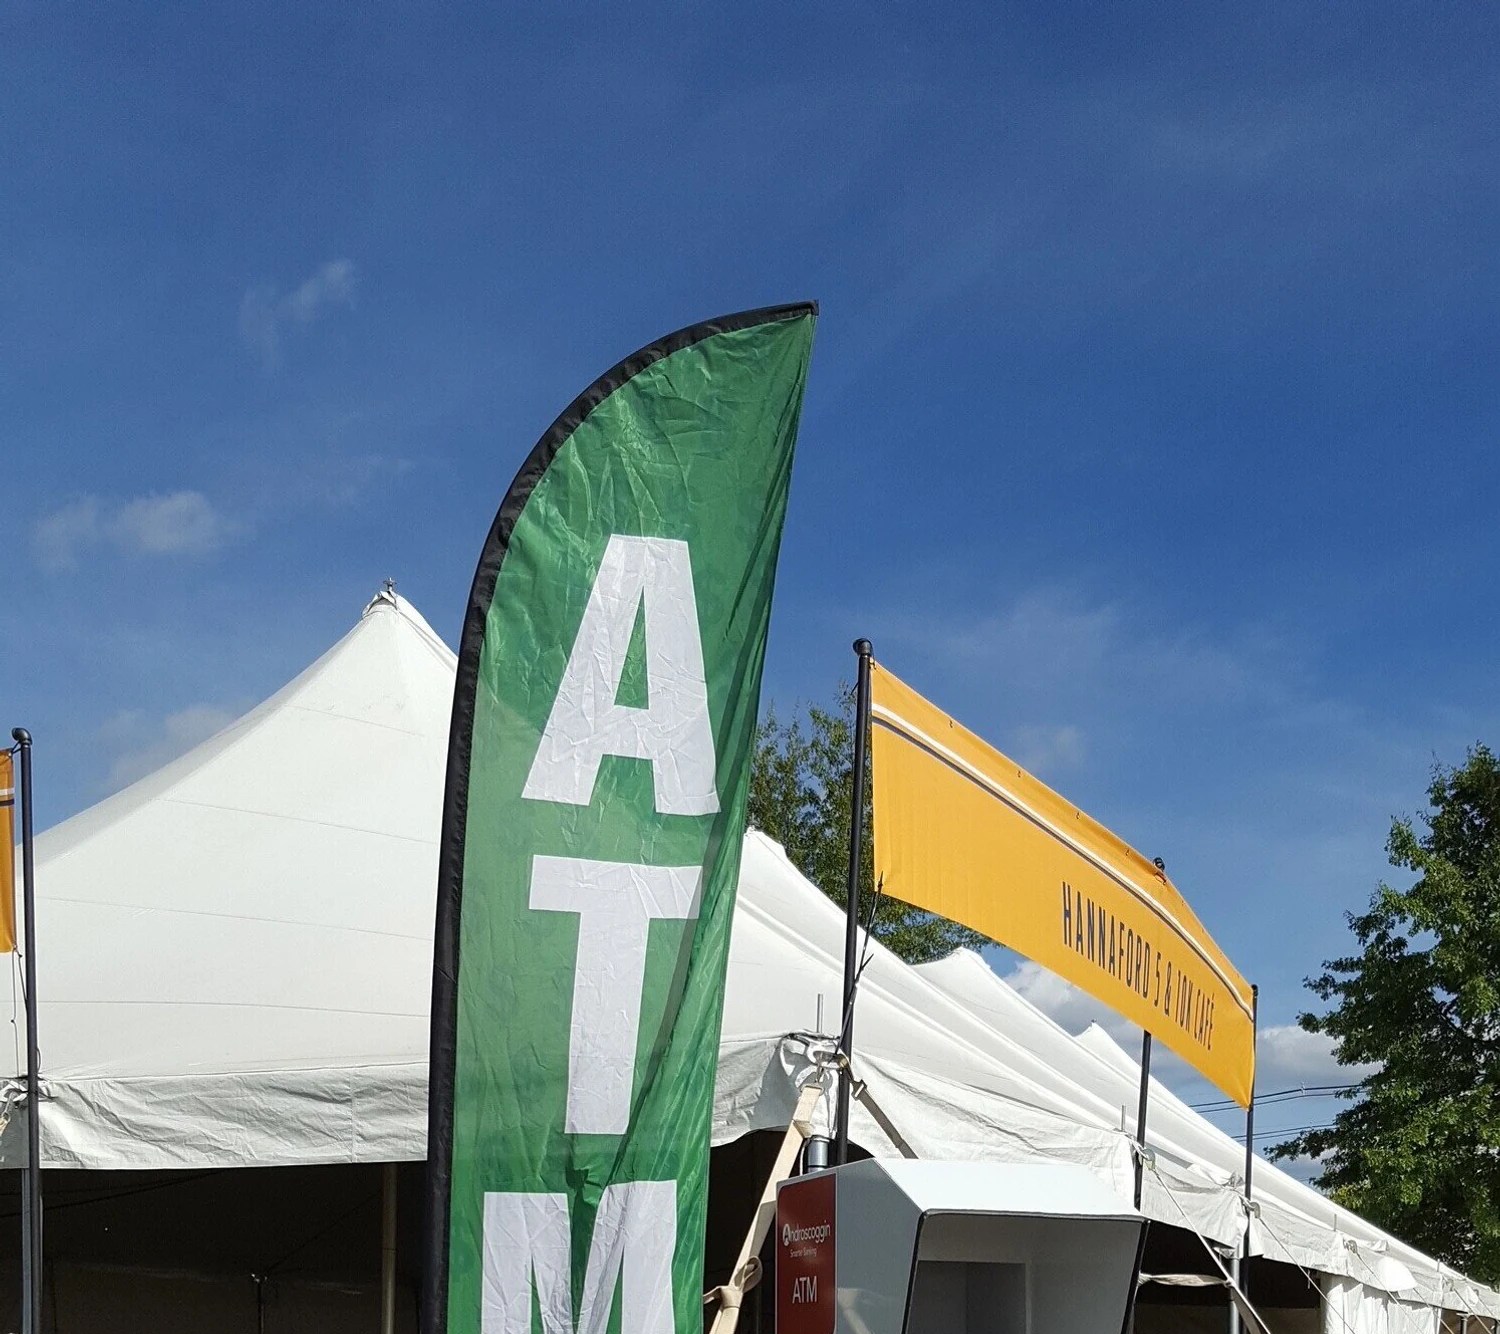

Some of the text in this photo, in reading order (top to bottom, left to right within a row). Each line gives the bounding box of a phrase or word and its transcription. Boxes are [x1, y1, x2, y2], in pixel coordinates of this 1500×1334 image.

[1062, 881, 1215, 1051] HANNAFORD 5 & 10K CAFÉ
[782, 1220, 831, 1247] Androscoggin
[792, 1275, 818, 1304] ATM
